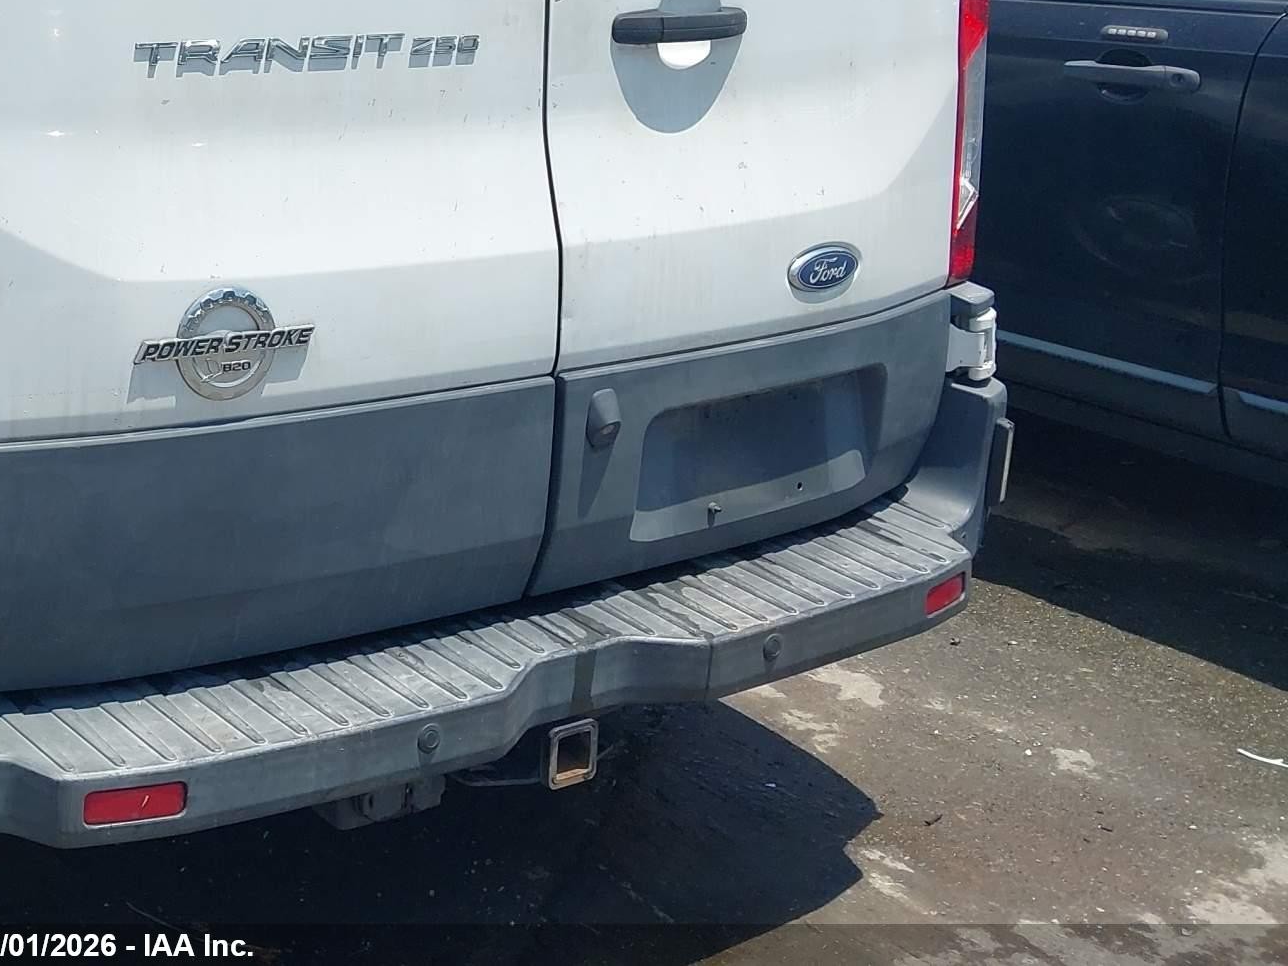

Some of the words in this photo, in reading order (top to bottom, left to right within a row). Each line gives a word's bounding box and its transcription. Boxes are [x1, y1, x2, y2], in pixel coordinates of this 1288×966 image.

[132, 32, 407, 68] TRANSIT
[411, 33, 481, 56] 250
[809, 256, 848, 284] Ford
